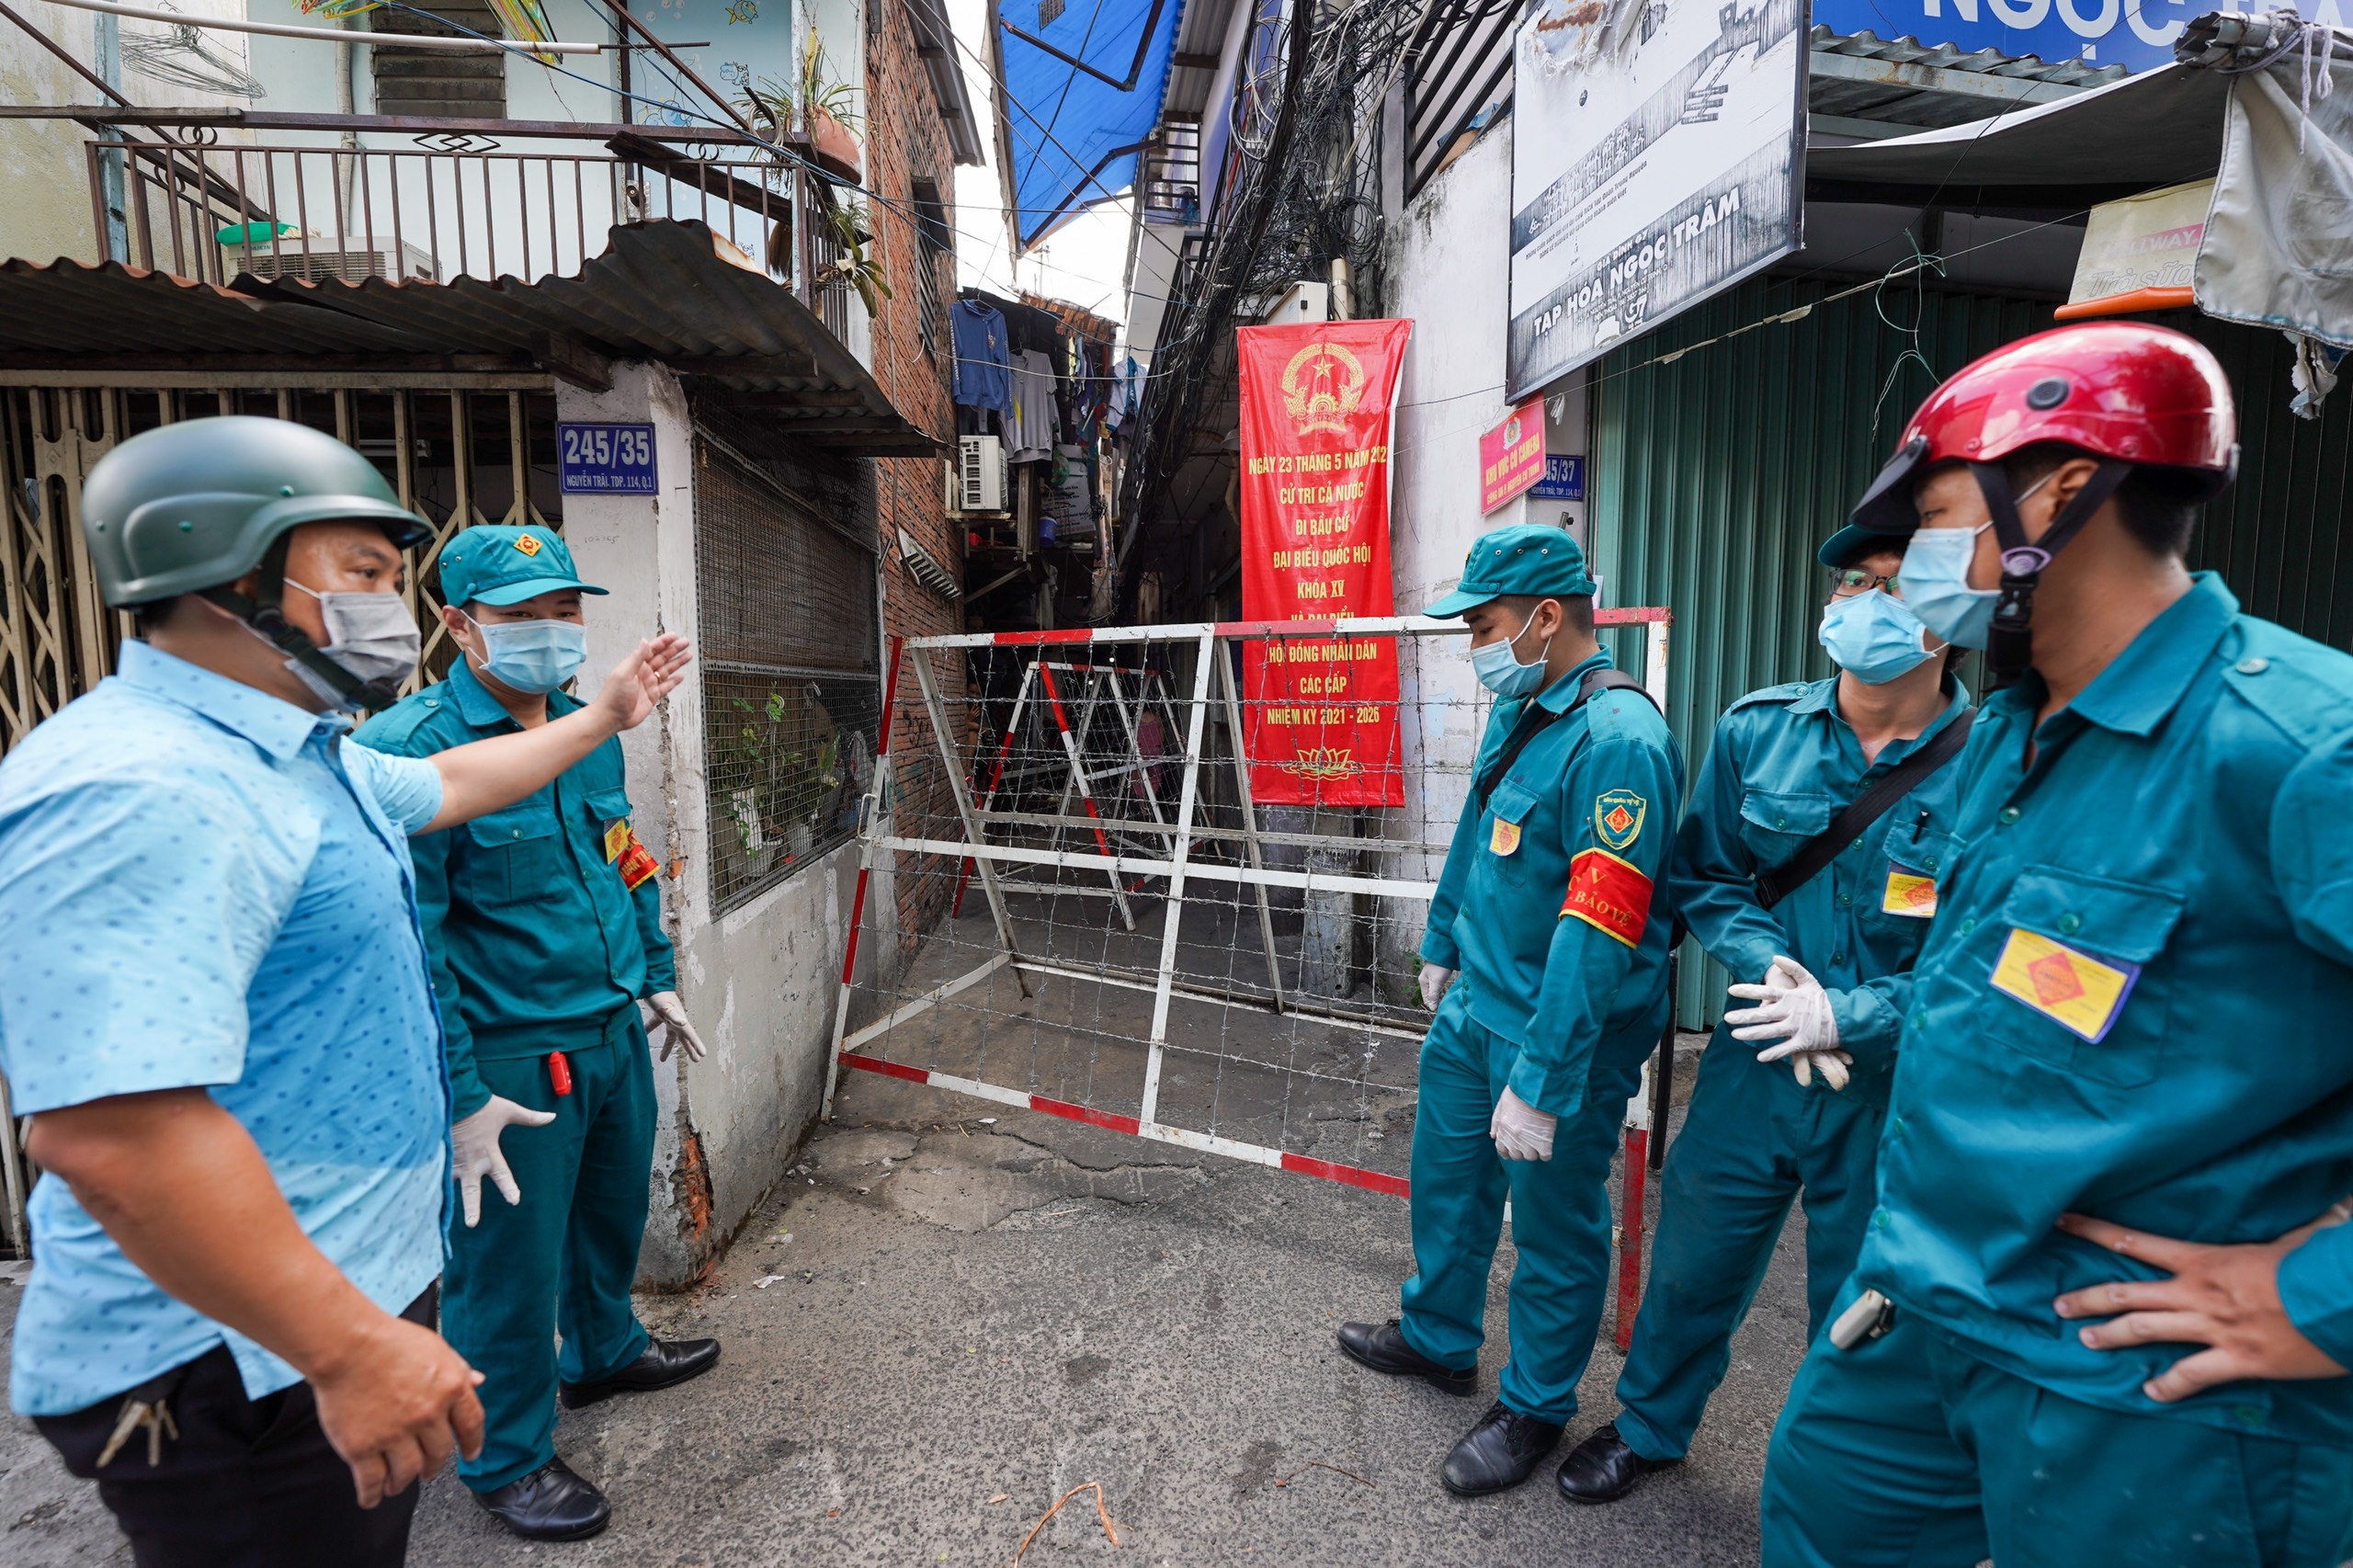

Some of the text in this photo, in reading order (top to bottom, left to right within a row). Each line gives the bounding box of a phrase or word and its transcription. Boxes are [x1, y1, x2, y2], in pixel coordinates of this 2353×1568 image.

[1534, 304, 1562, 338] TẠP
[1567, 278, 1603, 317] HÓA
[1610, 234, 1666, 290] NGỌC
[1673, 187, 1740, 249] TRÂM
[564, 429, 650, 469] 245/35
[1249, 445, 1387, 475] NGÀY 23 THÁNG 5 NĂM 202
[1485, 462, 1497, 487] KHU
[1518, 432, 1540, 465] CAMERA
[566, 470, 592, 487] NGUYỄN
[627, 476, 641, 489] 114,
[642, 476, 652, 489] Q.1
[1541, 459, 1575, 483] 45/37
[1280, 481, 1364, 505] CỬ TRI CẢ NƯỚC
[1295, 510, 1350, 536] ĐI BẦU CỬ
[1273, 542, 1371, 572] ĐẠI BIỂU QUỐC HỘI
[1297, 578, 1346, 598] KHÓA XV
[1289, 640, 1319, 663] ĐỒNG
[1322, 641, 1353, 661] NHÂN
[1356, 640, 1378, 660] DÂN
[1300, 671, 1347, 694] CÁC CẤP
[1267, 706, 1301, 728] NHIỆM
[1303, 705, 1317, 725] KỲ
[1320, 708, 1346, 725] 2021
[1356, 706, 1381, 723] 2026
[1610, 906, 1632, 927] VỆ
